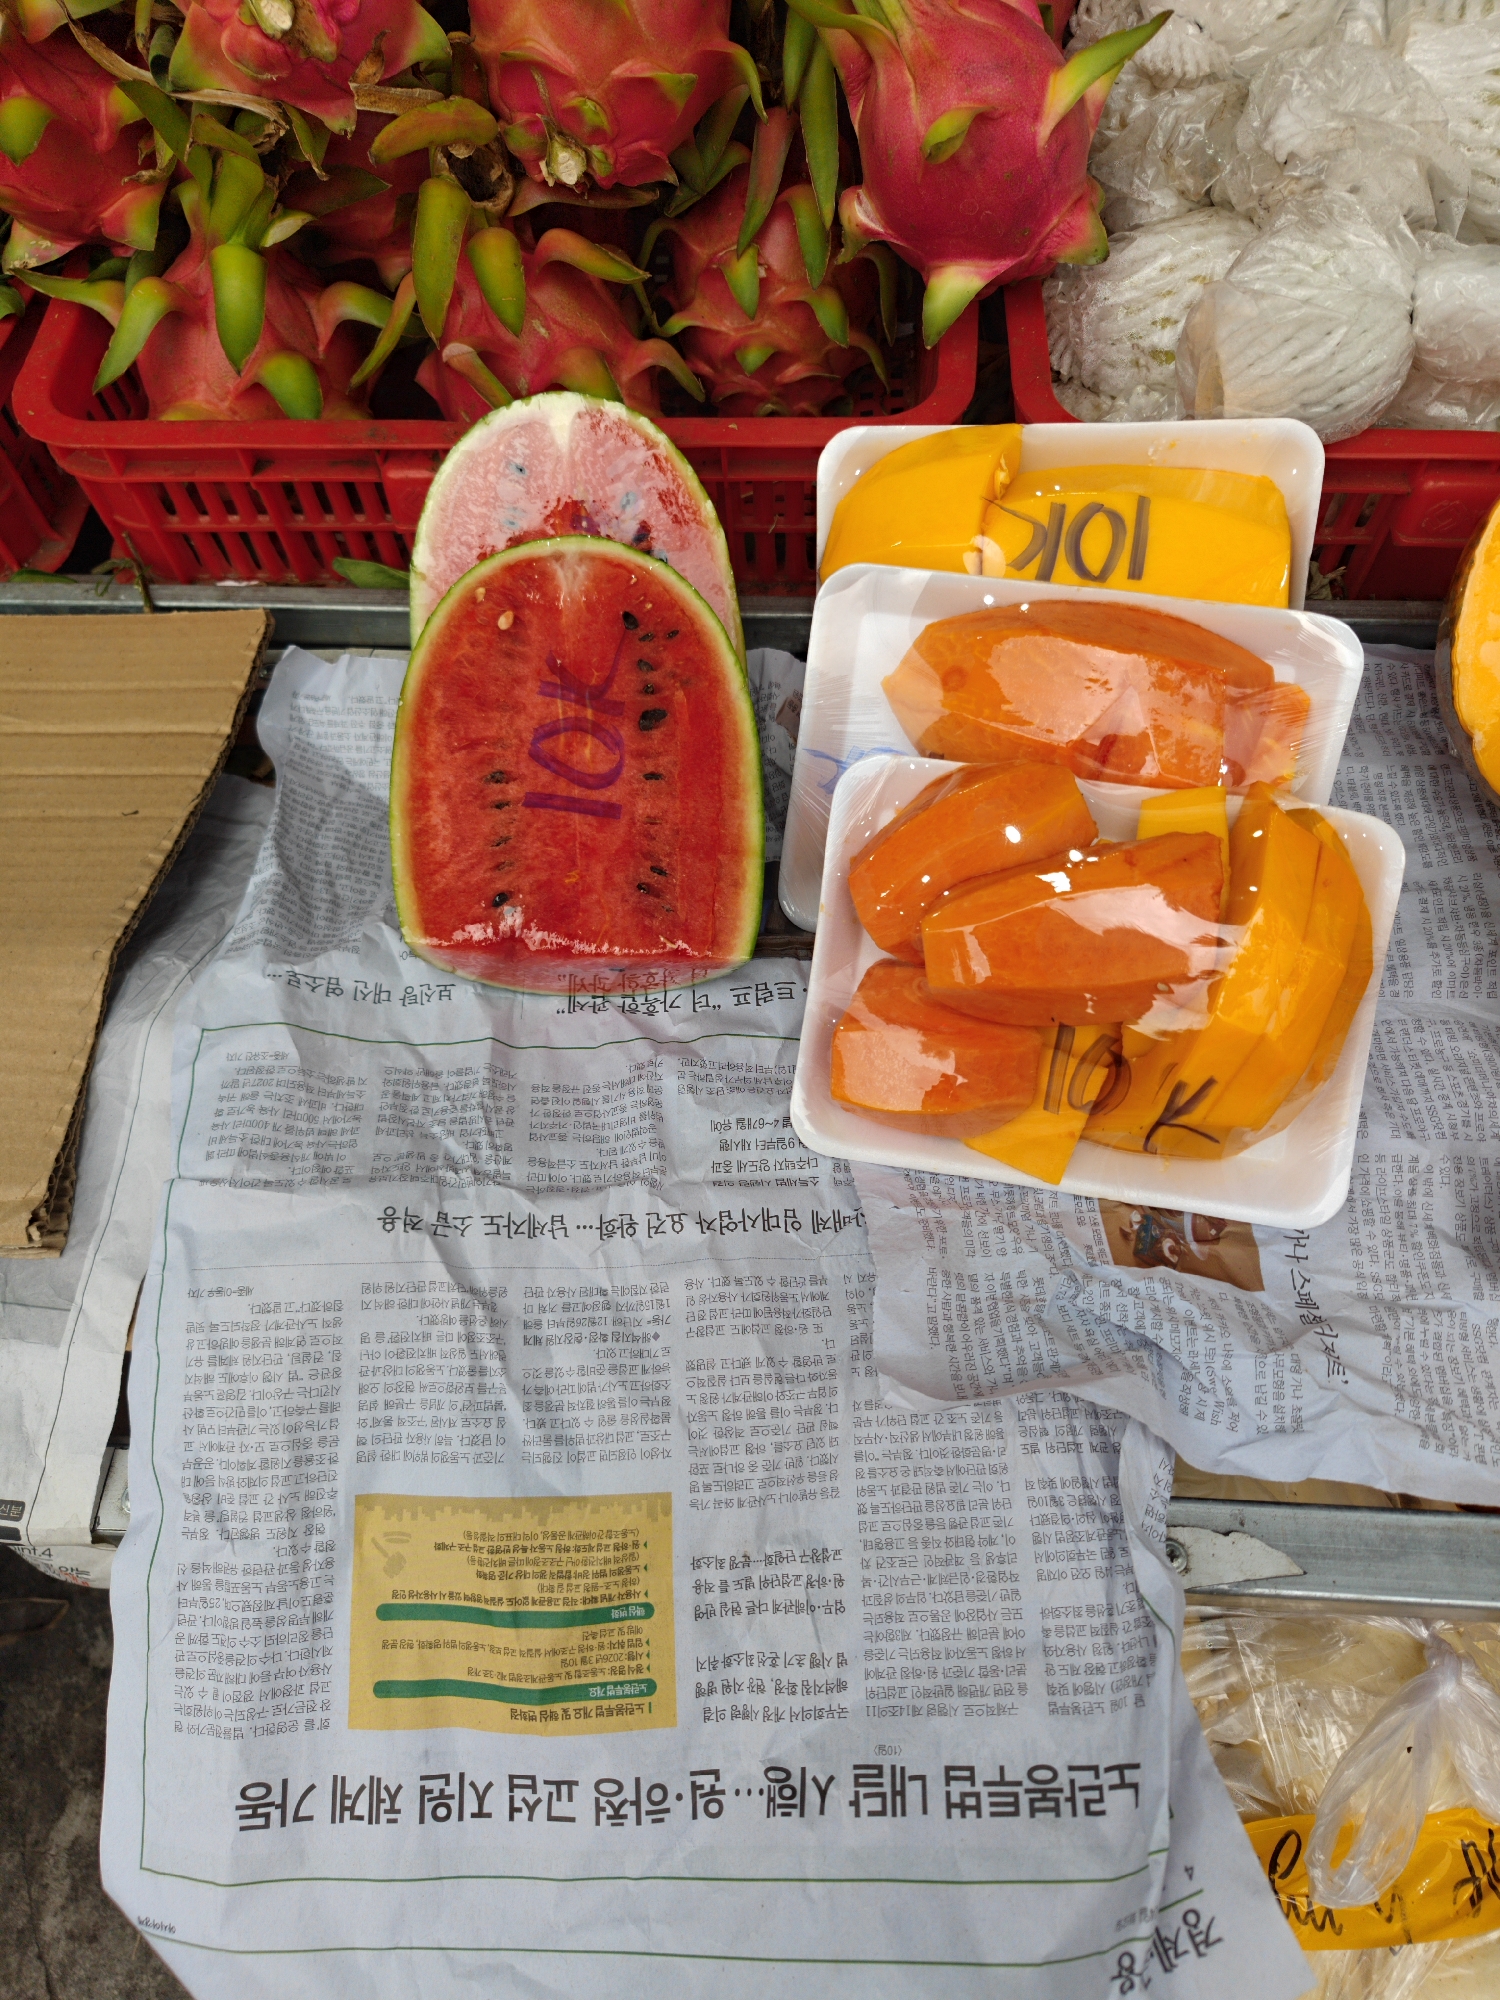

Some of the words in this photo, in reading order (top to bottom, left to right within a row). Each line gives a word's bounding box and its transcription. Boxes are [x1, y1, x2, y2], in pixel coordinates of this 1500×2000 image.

[521, 629, 626, 819] 10K
[354, 980, 391, 1005] 대신
[399, 983, 456, 1007] 보신탕
[730, 981, 796, 1007] 트럼프
[617, 991, 681, 1015] 가혹한
[227, 1052, 242, 1061] 기자
[711, 1119, 732, 1132] 유예
[736, 1117, 779, 1130] 4~6개월
[719, 1139, 751, 1151] 재시행
[756, 1138, 794, 1150] 9일부터
[711, 1161, 733, 1172] 중과
[737, 1159, 770, 1171] 양도세
[774, 1157, 818, 1169] 다주택자
[775, 1176, 819, 1187] 소득세법
[378, 1206, 423, 1233] 적용
[431, 1211, 473, 1237] 소급
[646, 1212, 688, 1237] 요건
[696, 1207, 801, 1233] 임대사업자
[481, 1213, 569, 1239] 납세자도
[1290, 1269, 1327, 1325] 스페셜
[434, 1542, 456, 1551] 구체화
[458, 1543, 471, 1552] 구조
[473, 1544, 485, 1554] 교섭
[487, 1545, 511, 1556] 반영한
[513, 1545, 528, 1555] 특성
[530, 1544, 554, 1555] 노동자
[556, 1544, 571, 1554] 하청
[573, 1544, 595, 1554] 제도화:
[597, 1542, 611, 1553] 교섭
[613, 1540, 640, 1552] 원·하청
[800, 1547, 843, 1564] 교섭창구
[691, 1555, 726, 1570] 최소화
[476, 1570, 495, 1580] 명확화
[498, 1571, 514, 1581] 기준
[515, 1570, 530, 1581] 대상
[532, 1570, 547, 1580] 쟁의
[549, 1570, 572, 1580] 합법적
[573, 1570, 590, 1579] 정비:
[593, 1568, 607, 1578] 범위
[609, 1564, 640, 1578] 노동쟁의
[693, 1578, 715, 1594] 적용
[719, 1578, 729, 1592] 틀
[733, 1575, 754, 1590] 별도
[759, 1573, 803, 1589] 교섭단위
[806, 1573, 845, 1589] 원·하청
[391, 1590, 407, 1600] 인정
[409, 1590, 438, 1599] 사용자성
[439, 1591, 446, 1599] 시
[448, 1591, 462, 1601] 있을
[464, 1593, 483, 1603] 영향력
[484, 1595, 504, 1605] 실질적
[531, 1595, 560, 1605] 고용관계
[562, 1596, 578, 1605] 직접
[580, 1594, 598, 1604] 확대:
[600, 1592, 616, 1602] 개념
[618, 1589, 641, 1601] 사용자
[506, 1596, 529, 1606] 없어도
[773, 1598, 846, 1615] 업무·이해관계
[611, 1609, 627, 1619] 변화
[629, 1606, 645, 1617] 핵심
[694, 1602, 716, 1620] 반영
[719, 1601, 742, 1617] 현실
[746, 1601, 768, 1615] 다른
[582, 1630, 598, 1641] 촉진
[600, 1628, 615, 1638] 교섭
[617, 1628, 624, 1636] 및
[627, 1626, 643, 1636] 예방
[382, 1639, 398, 1649] 분쟁
[399, 1639, 414, 1649] 현장
[416, 1639, 441, 1649] 명확화,
[443, 1639, 457, 1649] 범위
[459, 1641, 486, 1652] 노동쟁의
[578, 1641, 605, 1652] 원·하청
[607, 1640, 625, 1650] 취지:
[627, 1638, 643, 1648] 입법
[488, 1644, 501, 1655] 보장,
[503, 1646, 517, 1657] 교섭
[519, 1649, 542, 1657] 실질적
[544, 1646, 575, 1656] 구조에서
[581, 1655, 593, 1665] 3월
[596, 1652, 623, 1664] 2026년
[625, 1651, 643, 1661] 시행:
[722, 1652, 753, 1668] 최소화
[756, 1652, 780, 1668] 혼선
[784, 1652, 806, 1668] 초기
[810, 1653, 832, 1668] 시행
[837, 1653, 848, 1667] 법
[561, 1658, 578, 1668] 10일
[696, 1657, 719, 1671] 취지
[483, 1669, 507, 1681] 제2·3조
[564, 1670, 572, 1680] 및
[575, 1667, 606, 1679] 노동조합
[608, 1665, 626, 1676] 명칭:
[628, 1664, 643, 1675] 정식
[510, 1672, 562, 1684] 노동관계조정법
[589, 1686, 605, 1697] 개요
[607, 1684, 647, 1696] 노란봉투법
[695, 1681, 717, 1698] 병행
[722, 1680, 744, 1695] 지원
[748, 1679, 766, 1694] 현장
[771, 1678, 798, 1695] 확정,
[801, 1678, 848, 1696] 해석지침
[510, 1709, 537, 1722] 변화점
[540, 1710, 559, 1721] 핵심
[561, 1708, 571, 1720] 및
[573, 1706, 593, 1719] 개요
[596, 1702, 644, 1718] 노란봉투법
[703, 1707, 726, 1722] 의결
[731, 1705, 759, 1720] 시행령
[763, 1706, 785, 1720] 개정
[789, 1705, 849, 1723] 국무회의서
[866, 1704, 922, 1718] 제14조의11
[926, 1704, 959, 1717] 시행령
[963, 1703, 1019, 1716] 구체적으로
[851, 1764, 927, 1819] 내달
[945, 1761, 1141, 1819] 노란봉투법
[236, 1776, 316, 1831] 가동
[329, 1774, 402, 1826] 체계
[417, 1774, 492, 1824] 지원
[509, 1774, 579, 1824] 교섭
